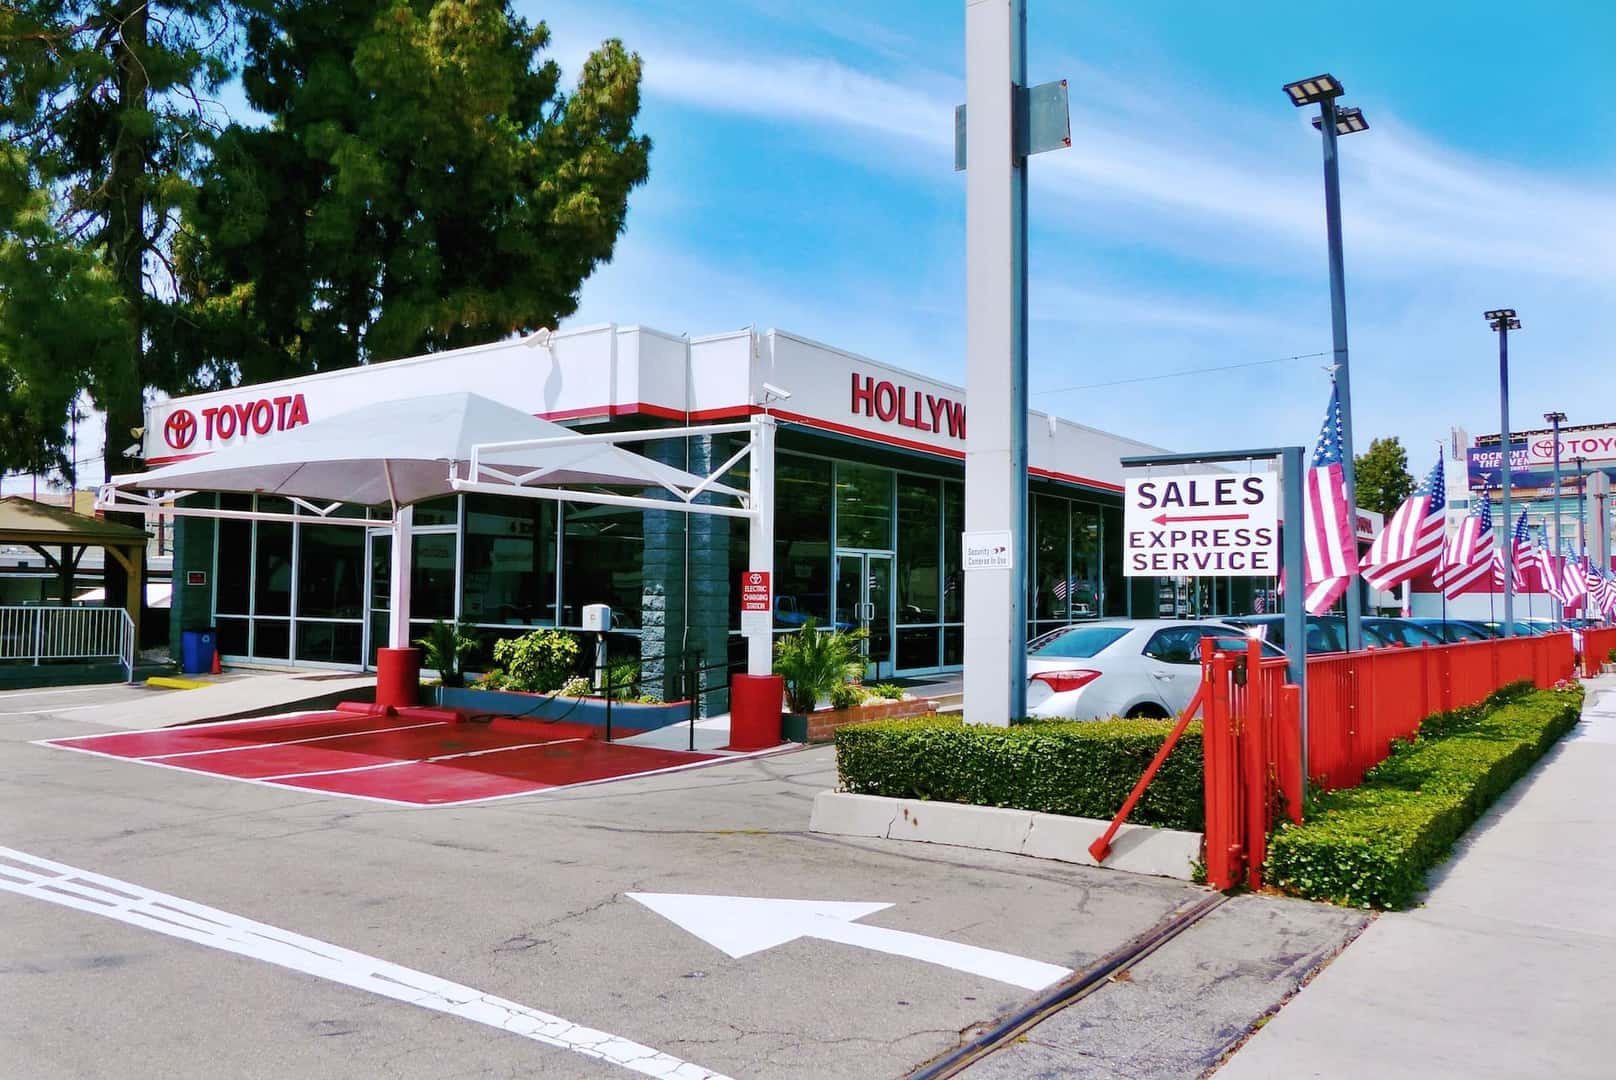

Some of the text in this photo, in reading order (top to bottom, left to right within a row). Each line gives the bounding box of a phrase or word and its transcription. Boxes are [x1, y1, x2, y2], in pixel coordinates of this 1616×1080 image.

[201, 393, 309, 441] TOYOTA
[1567, 437, 1616, 454] TOY
[1472, 452, 1503, 462] ROCK
[1479, 459, 1501, 469] THE
[1137, 476, 1265, 510] SALES
[1129, 527, 1273, 549] EXPRESS
[1132, 550, 1269, 571] SERVICE
